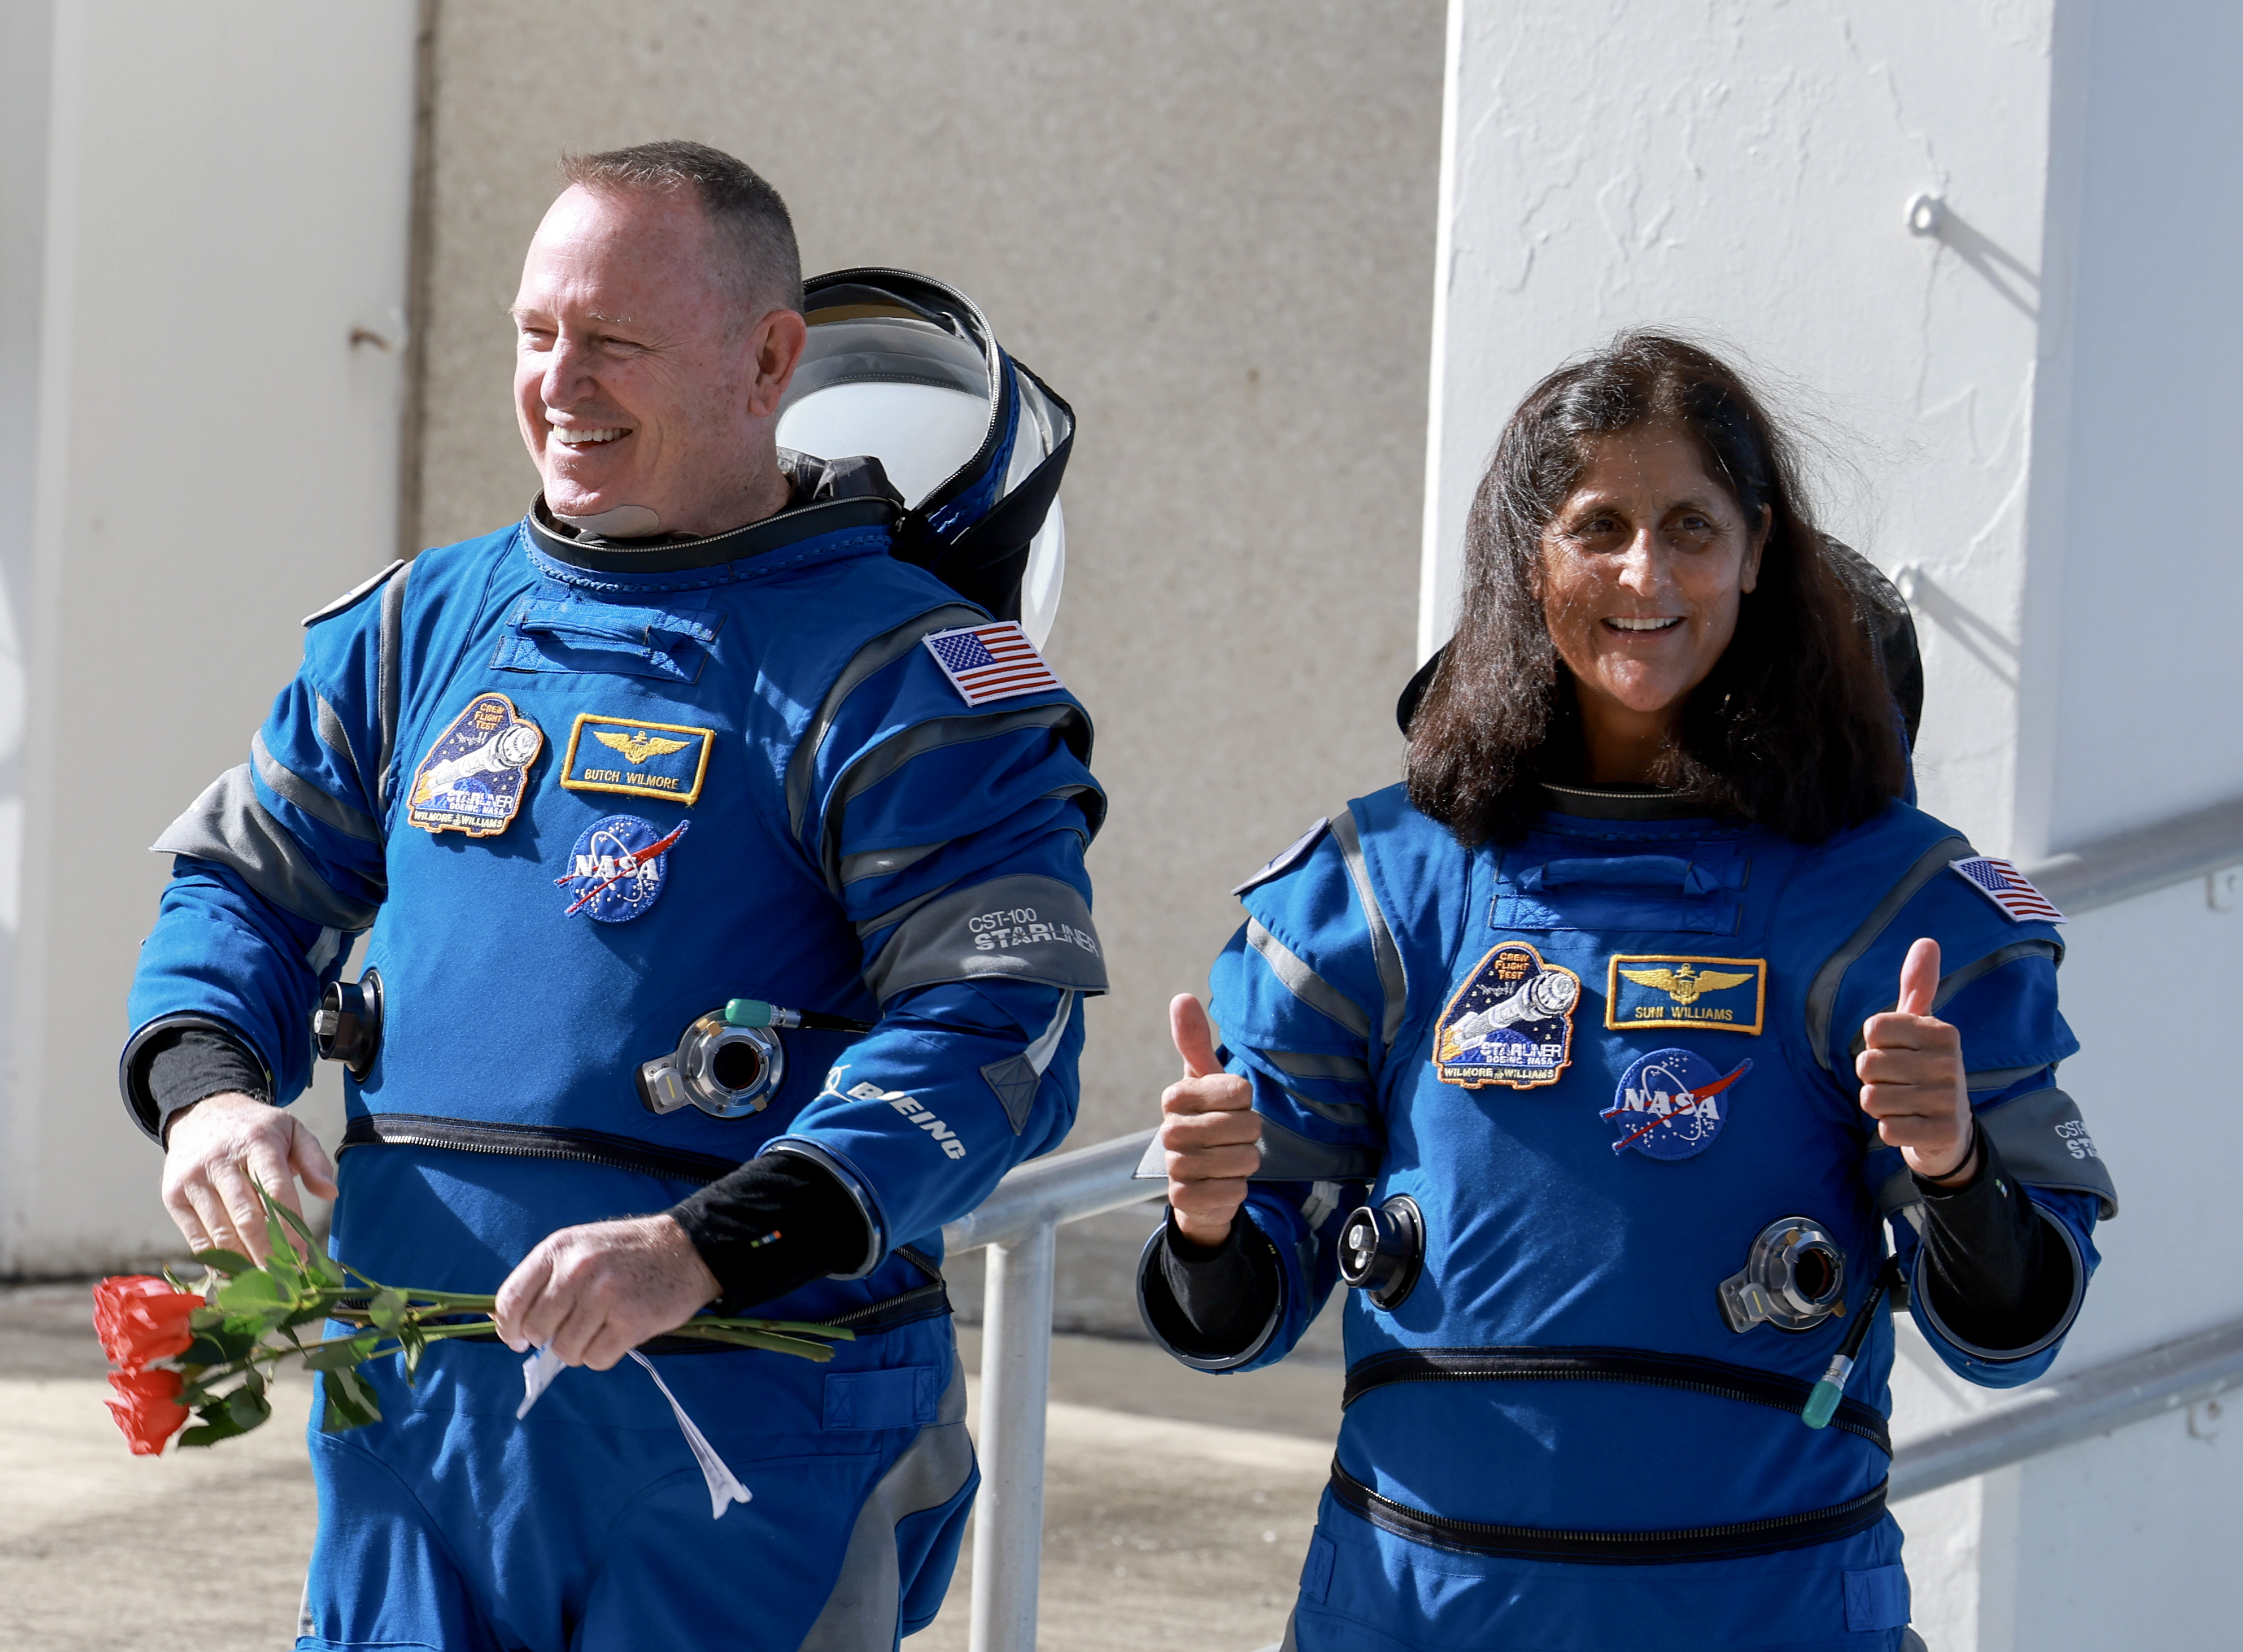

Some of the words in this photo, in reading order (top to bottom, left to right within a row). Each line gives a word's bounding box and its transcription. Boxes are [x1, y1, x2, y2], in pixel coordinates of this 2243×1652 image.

[480, 703, 505, 714] CREW
[474, 711, 503, 722] FLIGHT
[476, 720, 497, 730] TEST
[584, 768, 621, 782] BUTCH
[626, 772, 679, 790] WILMORE
[446, 789, 513, 808] STARLINER
[482, 806, 505, 815] NASA
[414, 810, 453, 822] WILMORE
[461, 815, 503, 828] WILLIAMS
[572, 855, 660, 881] NASA
[968, 908, 1037, 933] CST-100
[974, 922, 1100, 958] STARLINER
[1499, 952, 1530, 962] CREW
[1495, 960, 1530, 970] FLIGHT
[1498, 969, 1524, 979] TEST
[1635, 1006, 1664, 1019] SUNI
[1671, 1006, 1733, 1021] WILLIAMS
[1480, 1042, 1562, 1058] STARLINER
[1527, 1056, 1553, 1065] NASA
[1444, 1067, 1493, 1077] WILMORE
[1504, 1068, 1555, 1079] WILLIAMS
[1622, 1088, 1720, 1120] NASA
